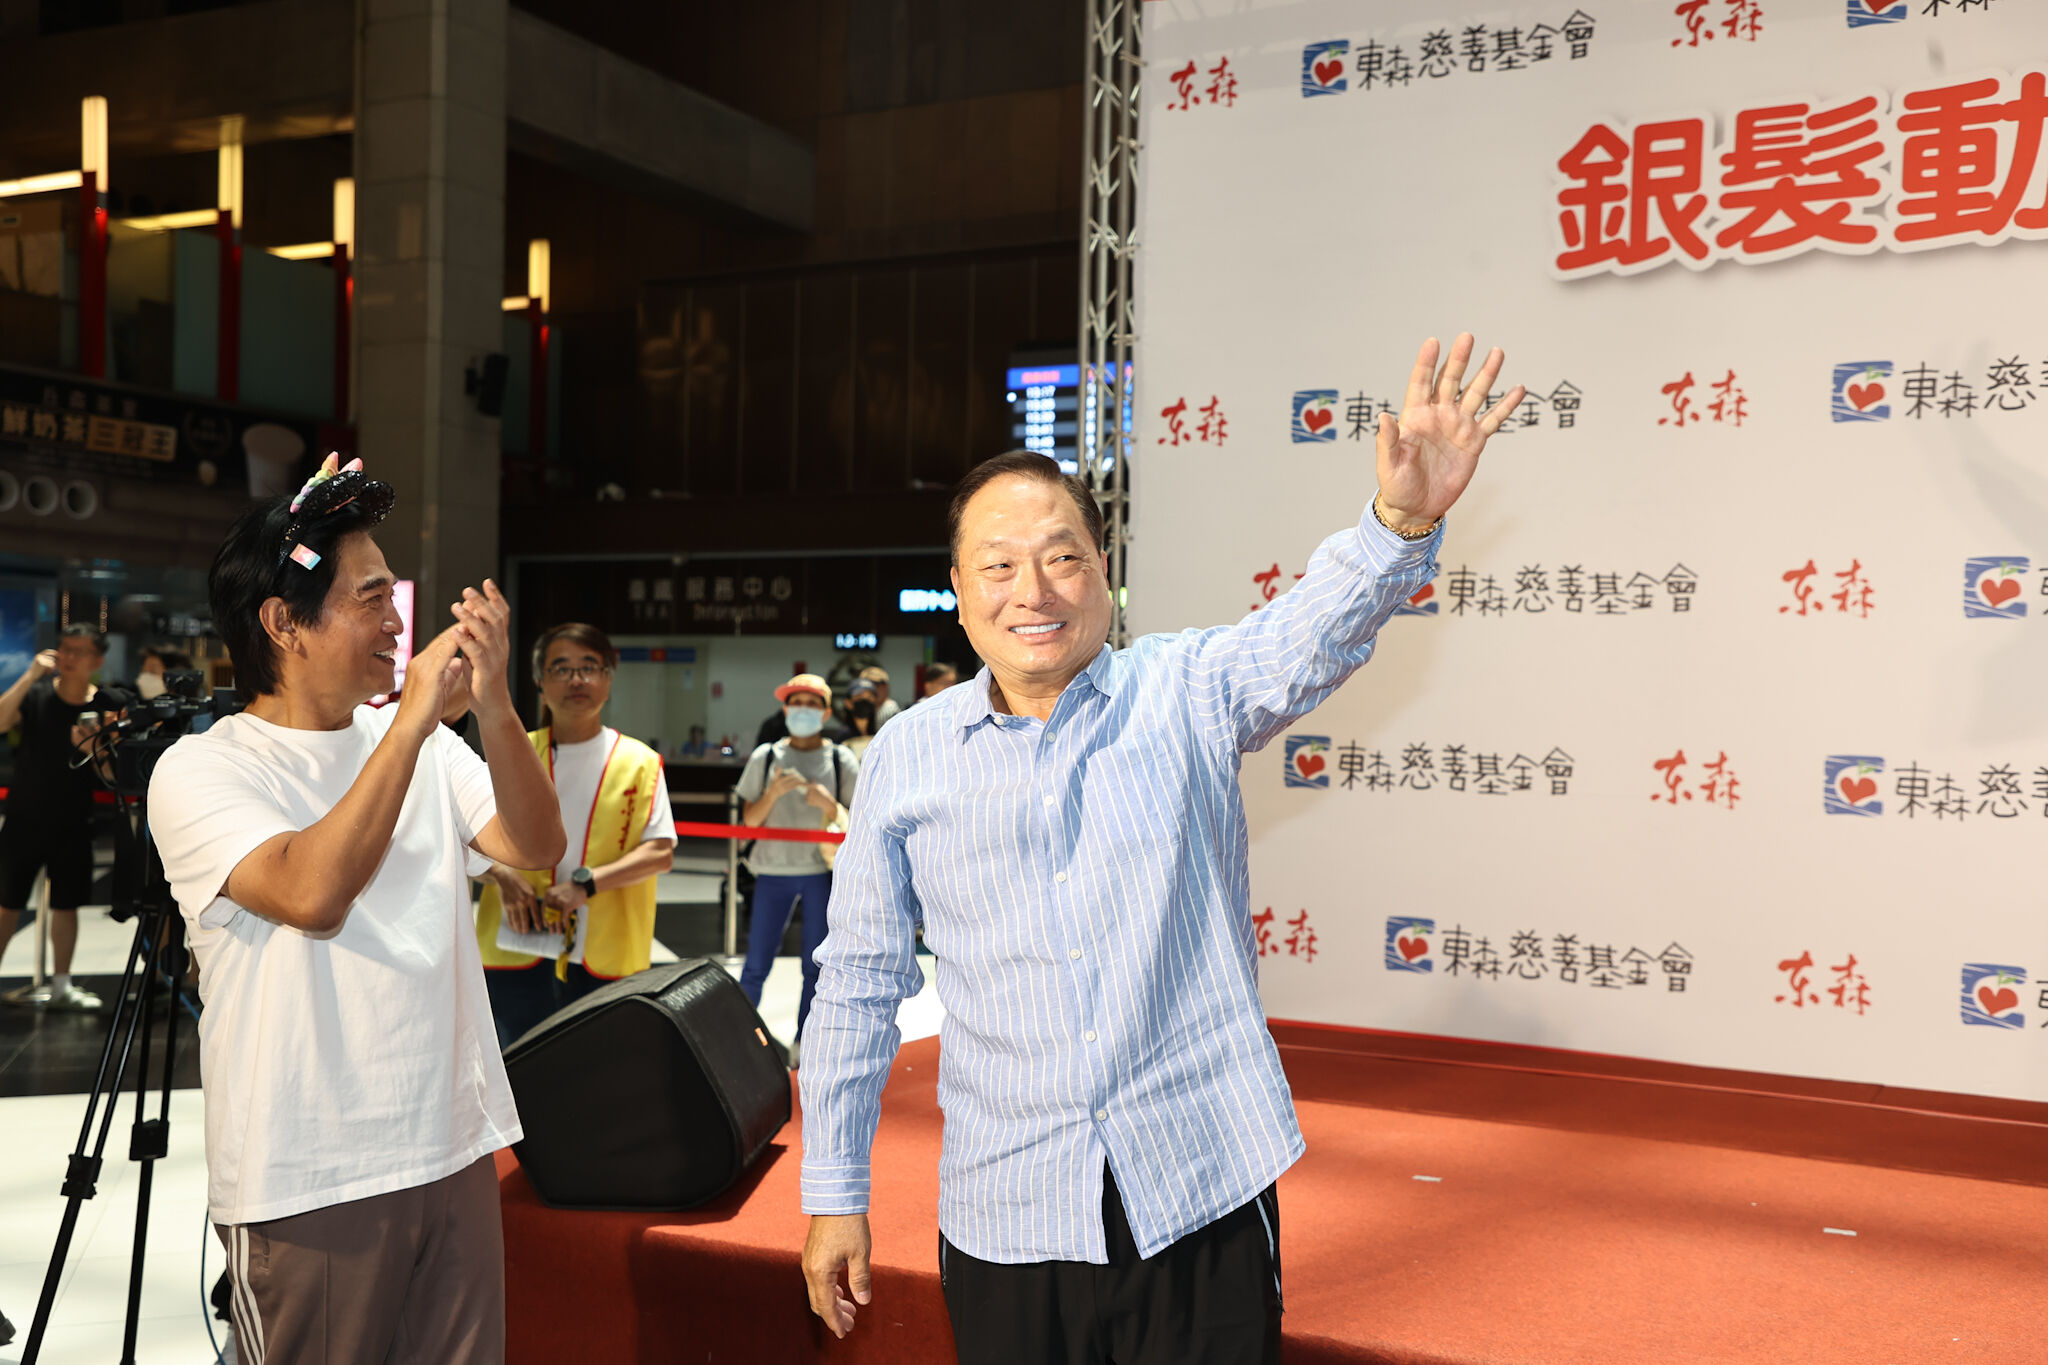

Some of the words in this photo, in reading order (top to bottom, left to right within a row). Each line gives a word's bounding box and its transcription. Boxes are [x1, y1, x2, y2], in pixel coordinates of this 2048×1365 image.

[1356, 9, 1597, 90] 東森慈善基金會
[1167, 57, 1239, 111] 东森
[1556, 72, 2048, 270] 銀髮動
[1658, 369, 1749, 428] 东森
[1902, 355, 2048, 420] 東森慈
[1158, 395, 1229, 446] 东森
[1447, 563, 1698, 617] 東森慈善基金會
[1779, 559, 1876, 619] 东森
[1337, 739, 1574, 796] 東森慈善基金會
[1650, 749, 1741, 809] 东森
[1442, 924, 1693, 992] 東森慈善基金會
[1774, 950, 1872, 1016] 东森
